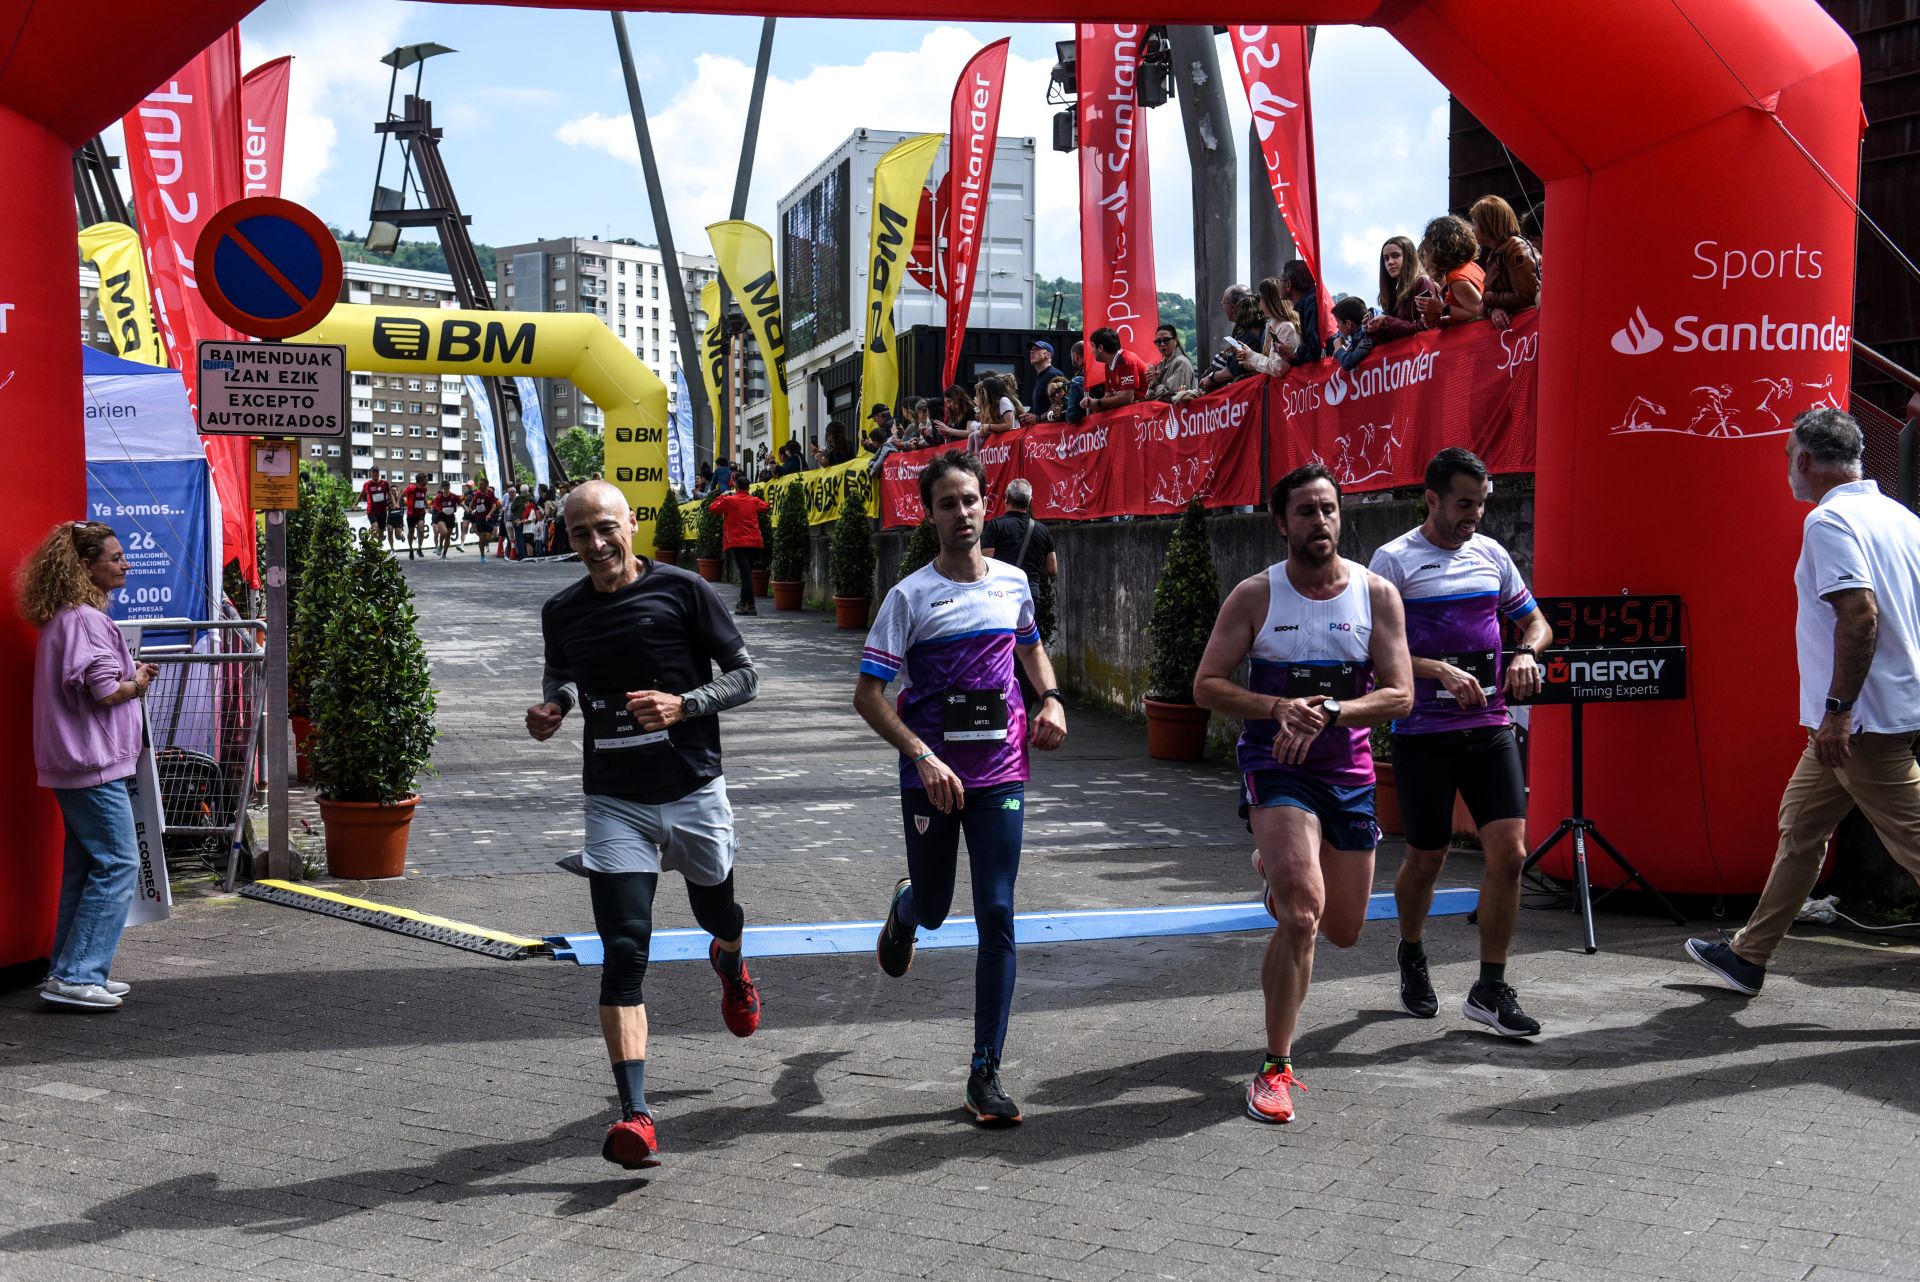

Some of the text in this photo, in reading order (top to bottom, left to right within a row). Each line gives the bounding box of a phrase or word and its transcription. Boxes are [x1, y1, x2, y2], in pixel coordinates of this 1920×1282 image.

[1692, 240, 1822, 289] Sports
[1672, 315, 1850, 352] Santander
[437, 320, 537, 365] BM
[210, 349, 333, 367] BAIMENDUAK
[224, 369, 319, 385] IZAN EZIK
[1282, 350, 1440, 420] Sports Santander
[229, 393, 315, 409] EXCEPTO
[206, 411, 337, 428] AUTORIZADOS
[1180, 398, 1249, 438] Santander
[634, 427, 662, 442] BM
[635, 467, 663, 482] BM
[92, 503, 185, 516] Ya somos...
[636, 507, 661, 522] BM
[129, 532, 156, 550] 26
[123, 552, 168, 560] EDERACIONES
[118, 587, 172, 604] 6.000
[1329, 622, 1351, 633] P4Q
[1571, 684, 1660, 699] Timing Experts
[138, 840, 157, 899] CORREO
